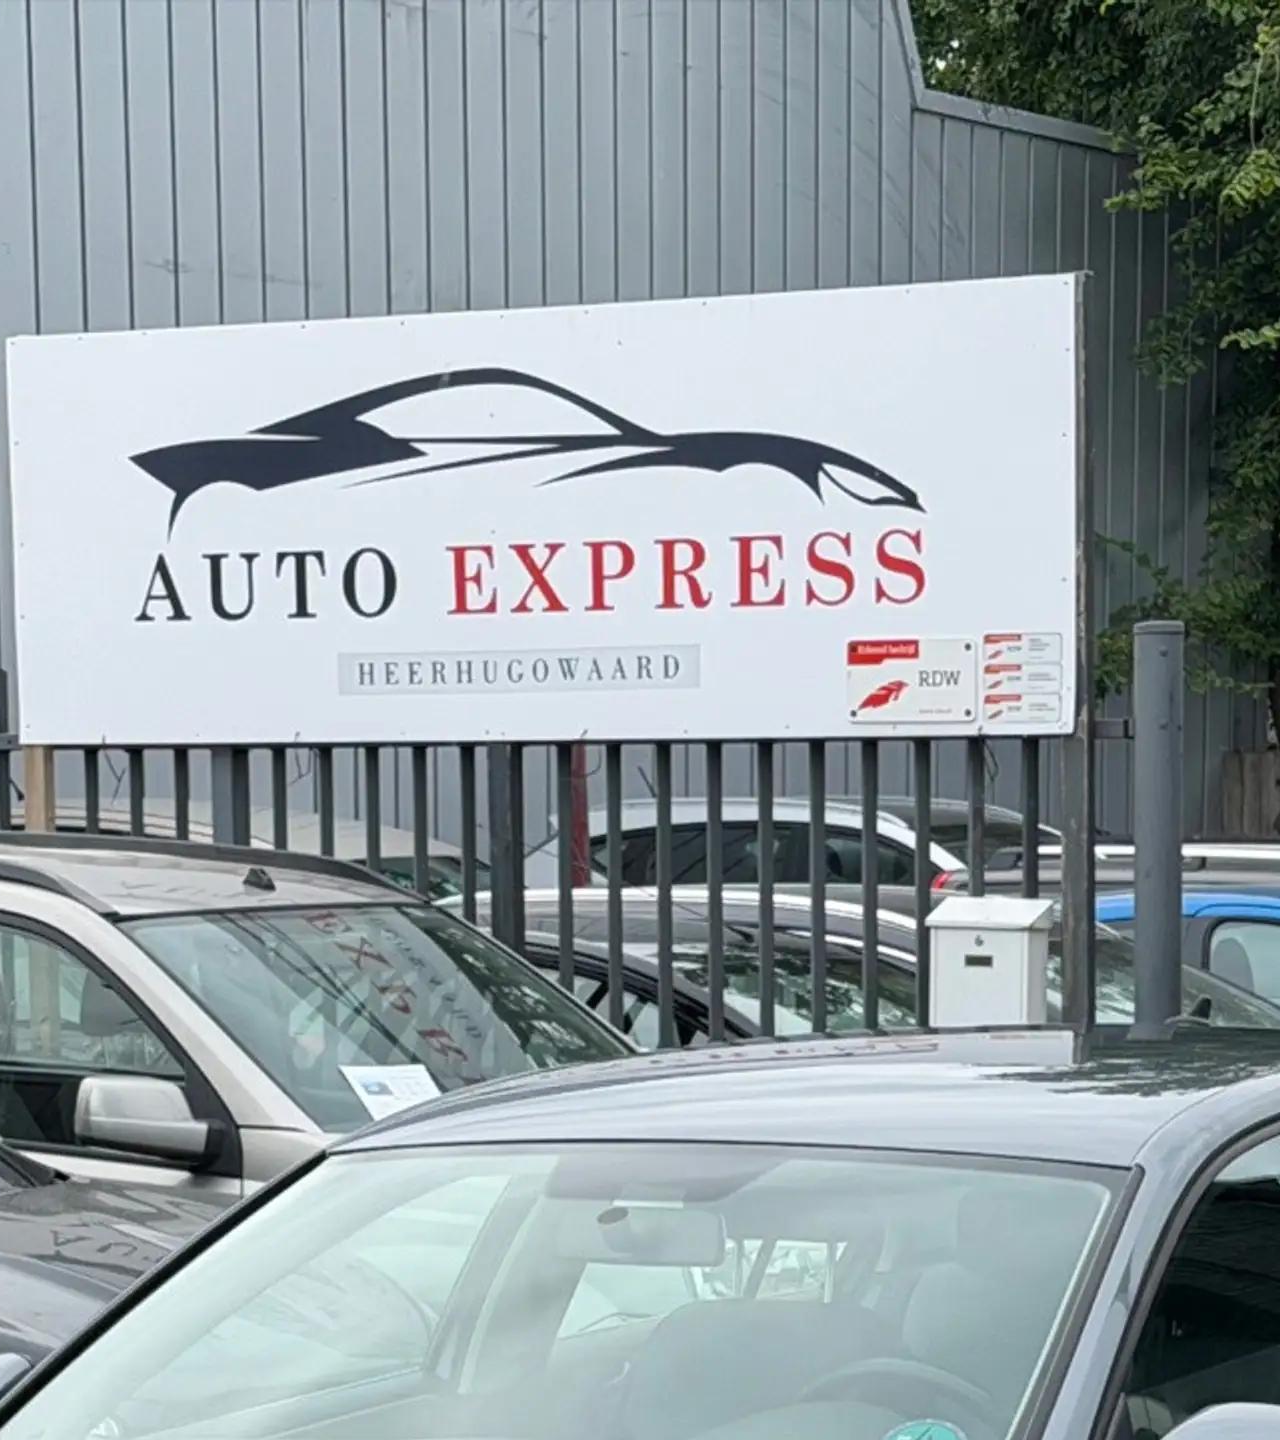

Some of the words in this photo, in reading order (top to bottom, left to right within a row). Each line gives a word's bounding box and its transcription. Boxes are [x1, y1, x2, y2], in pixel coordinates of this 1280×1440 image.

[135, 547, 398, 622] AUTO
[447, 529, 927, 615] EXPRESS
[357, 654, 682, 687] HEERHUGOWAARD
[918, 670, 961, 687] RDW
